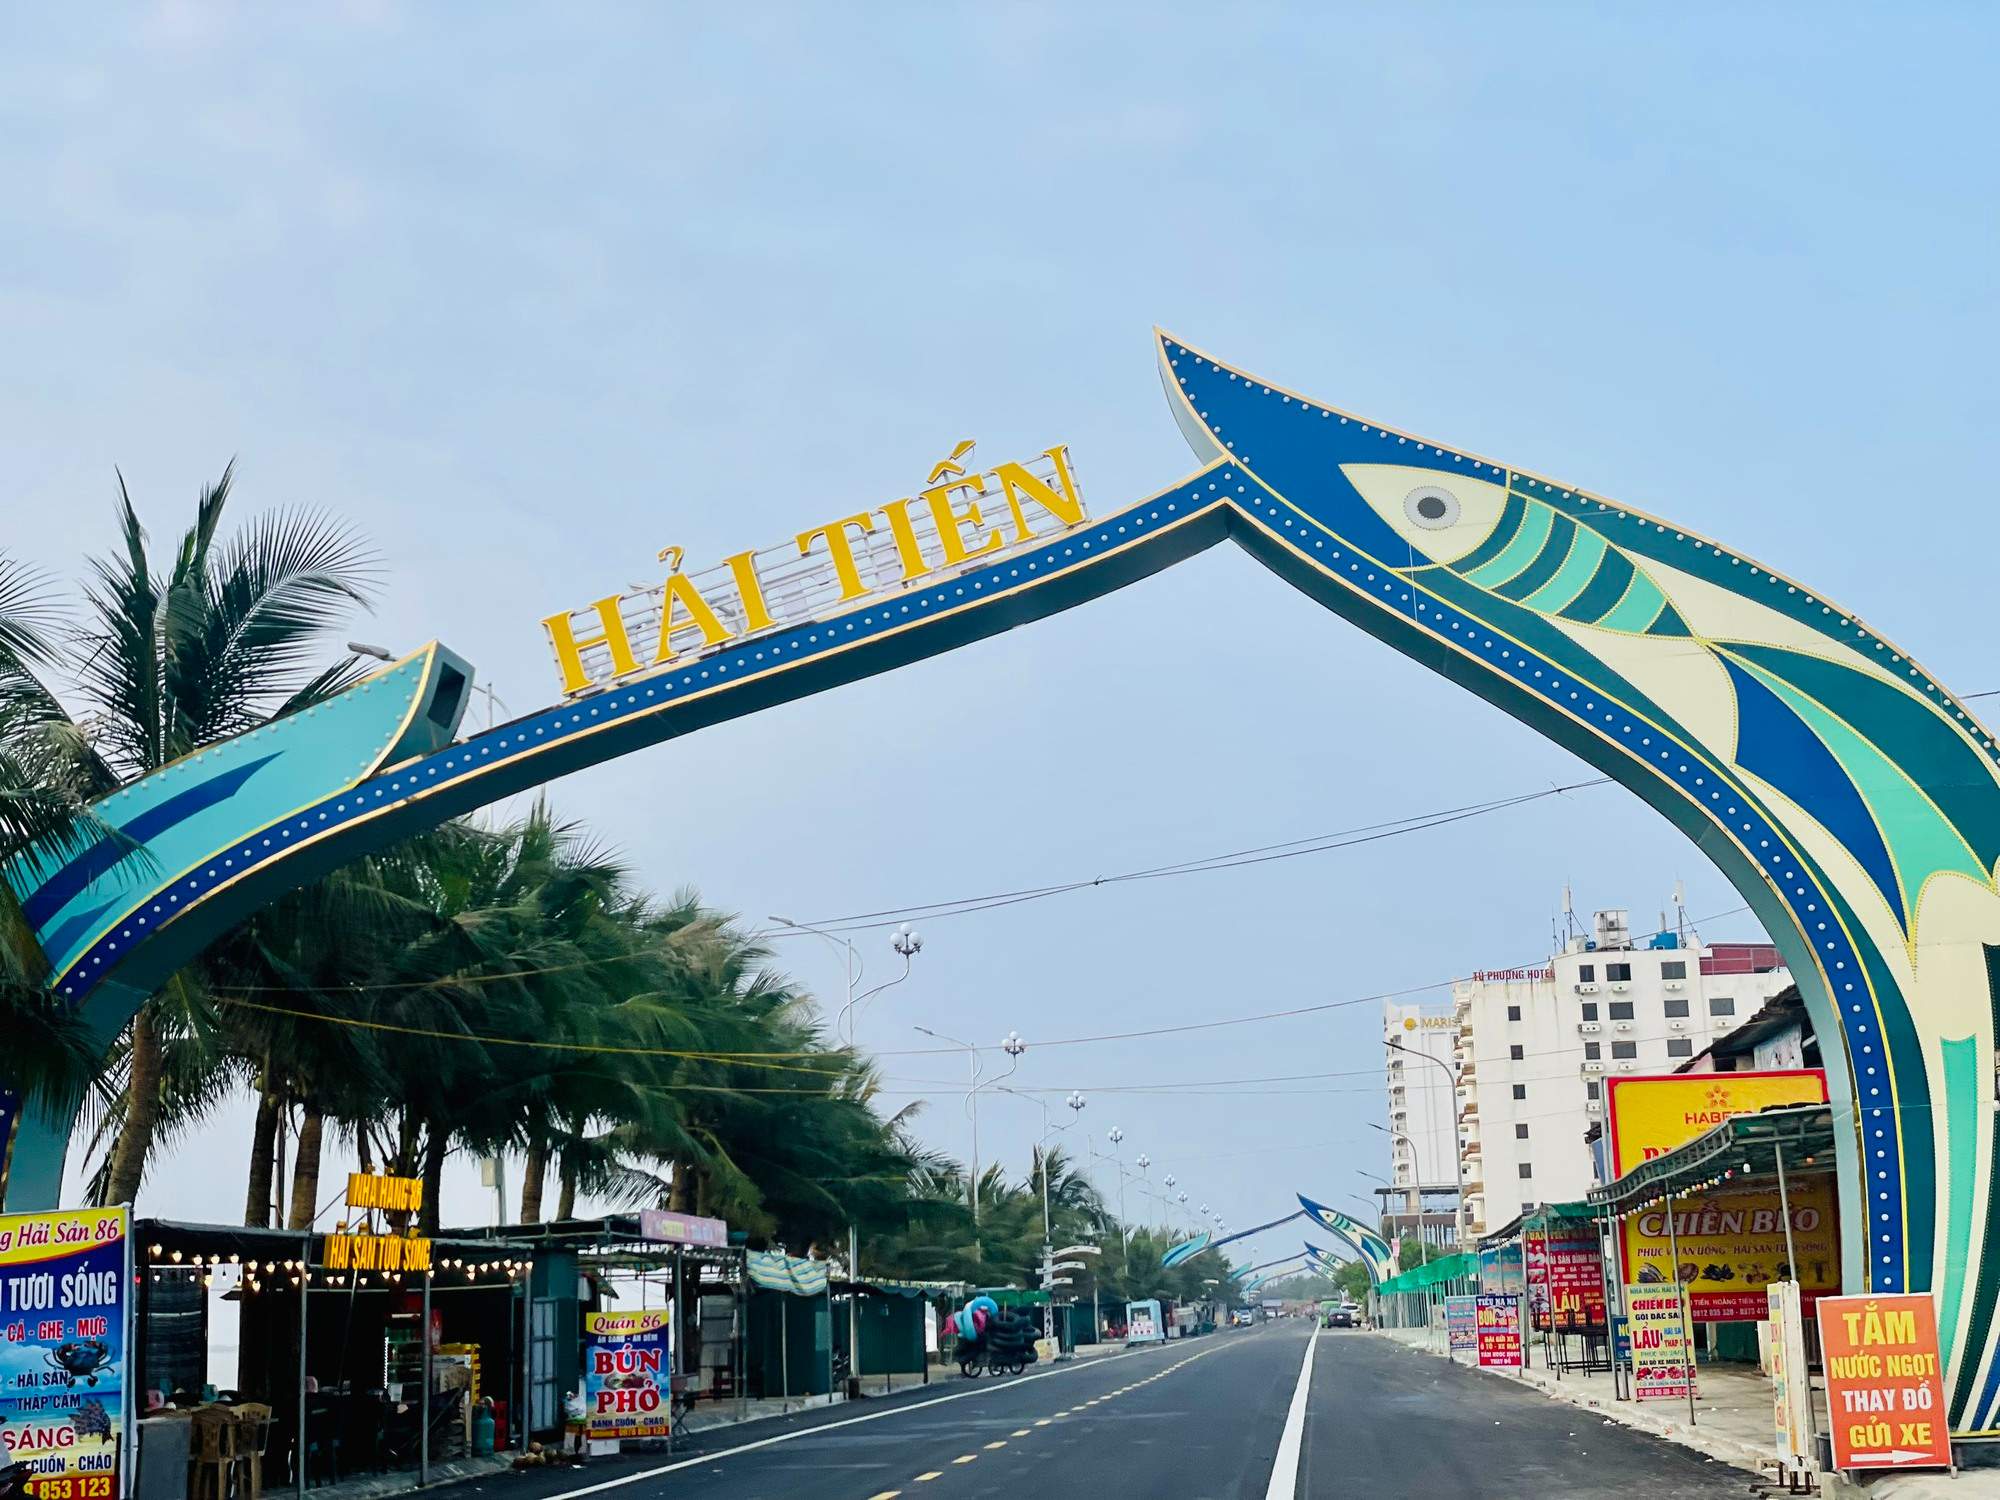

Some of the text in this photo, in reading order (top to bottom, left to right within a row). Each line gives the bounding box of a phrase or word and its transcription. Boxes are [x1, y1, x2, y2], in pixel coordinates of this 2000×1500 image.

[541, 440, 1085, 692] HẢI TIẾN
[1527, 968, 1555, 979] HOTEL
[17, 1223, 50, 1247] Hải
[54, 1221, 89, 1244] Sản
[95, 1218, 119, 1241] 86
[9, 1272, 54, 1311] TƯƠI
[61, 1261, 116, 1308] SỐNG
[38, 1321, 63, 1342] GHẸ
[77, 1316, 107, 1340] MỰC
[641, 1314, 661, 1329] 86
[1632, 1321, 1661, 1349] LẨU
[1842, 1301, 1916, 1346] TẮM
[594, 1344, 661, 1374] BÚN
[1830, 1350, 1934, 1381] NƯỚC NGỌT
[17, 1368, 38, 1388] HẢI
[597, 1380, 660, 1414] PHỞ
[1842, 1380, 1933, 1412] THAY ĐỒ
[1, 1423, 75, 1451] SÁNG
[1850, 1416, 1933, 1448] GỬI XE
[31, 1453, 65, 1475] CUỐN
[40, 1480, 72, 1500] 853
[79, 1477, 110, 1498] 123
